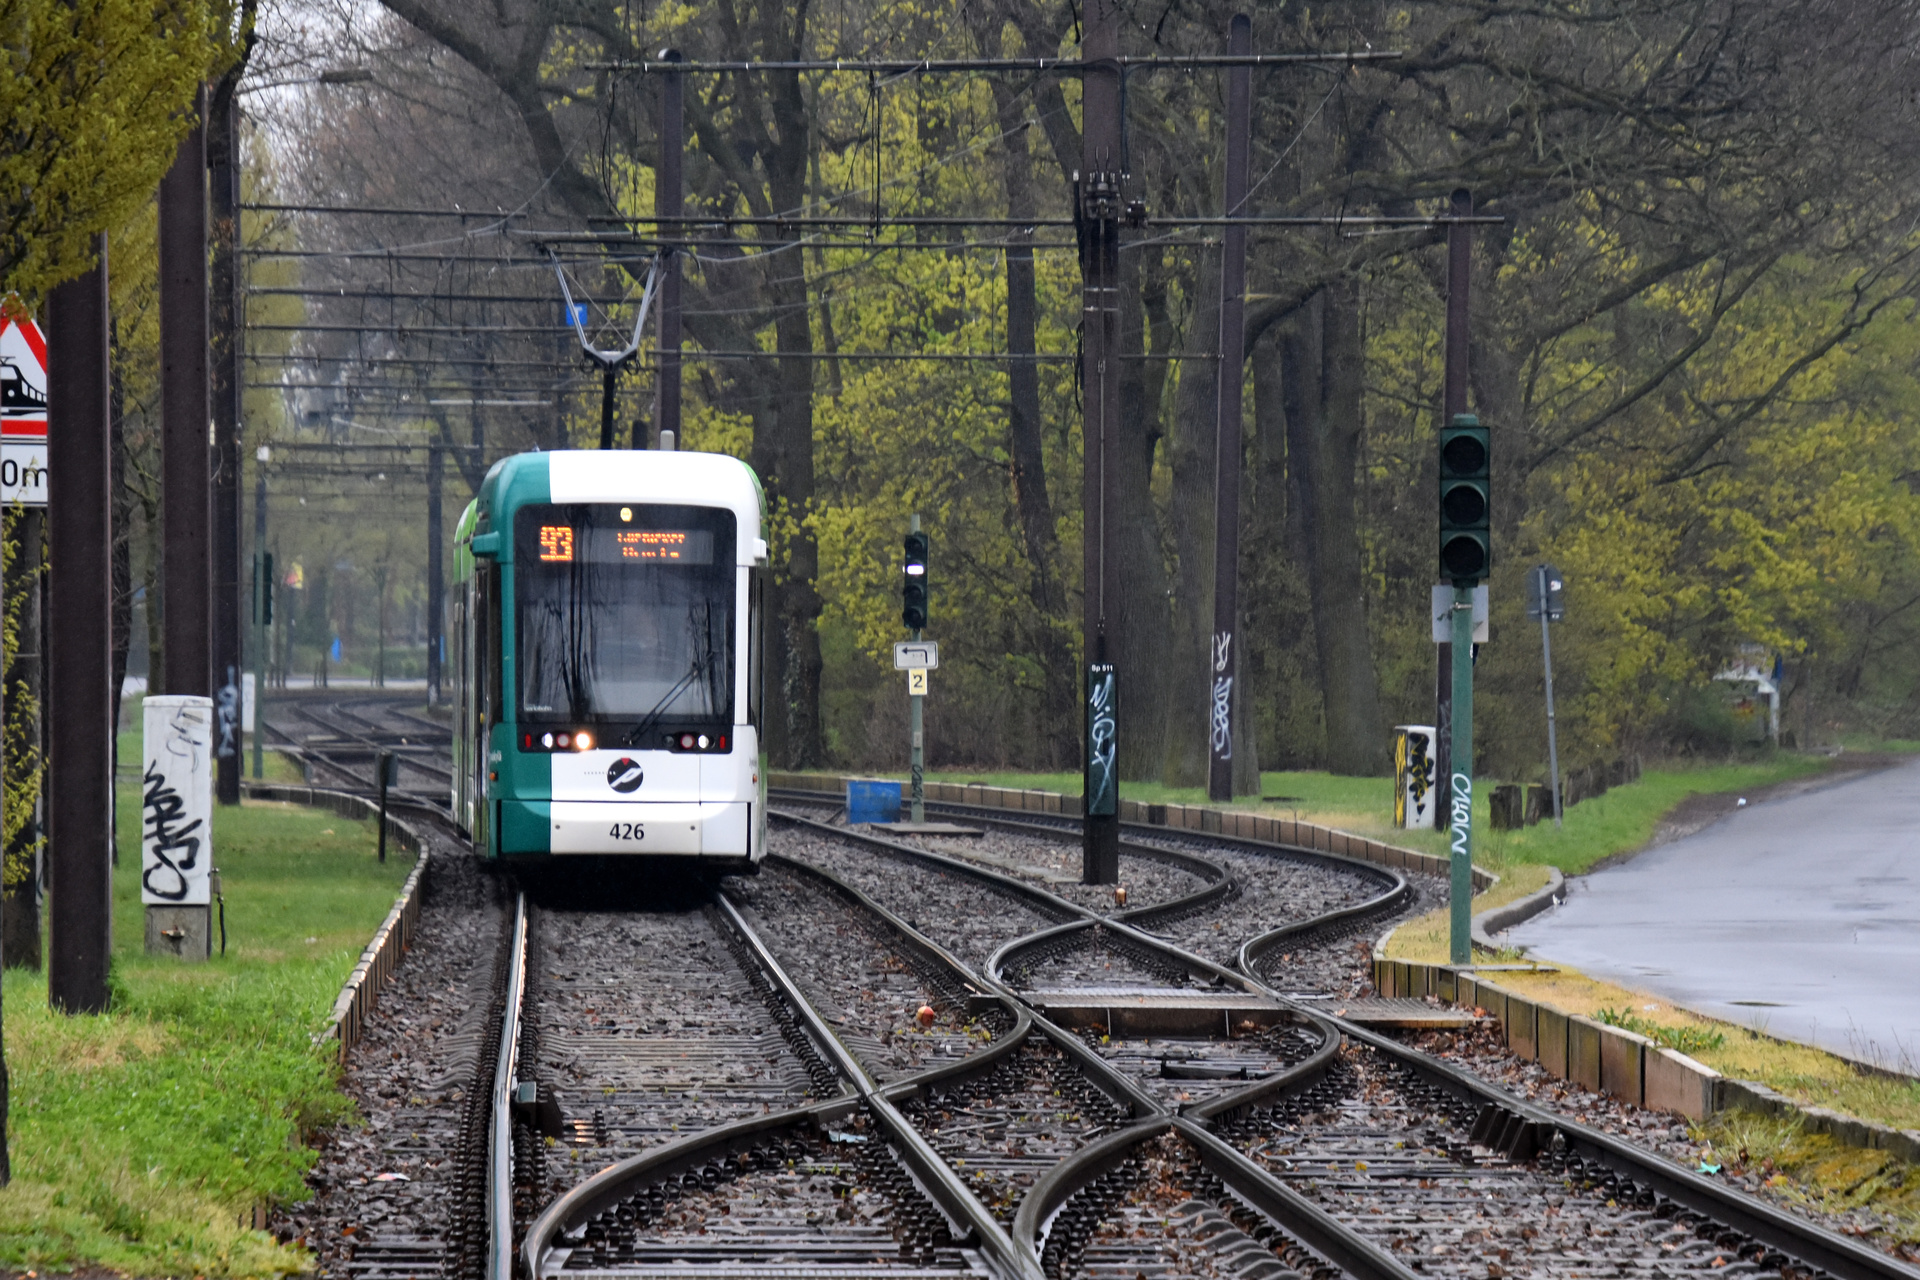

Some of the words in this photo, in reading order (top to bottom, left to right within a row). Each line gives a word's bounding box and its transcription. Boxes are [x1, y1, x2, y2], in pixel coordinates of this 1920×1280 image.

[540, 526, 573, 561] 93
[913, 673, 923, 688] 2
[609, 823, 645, 840] 426
